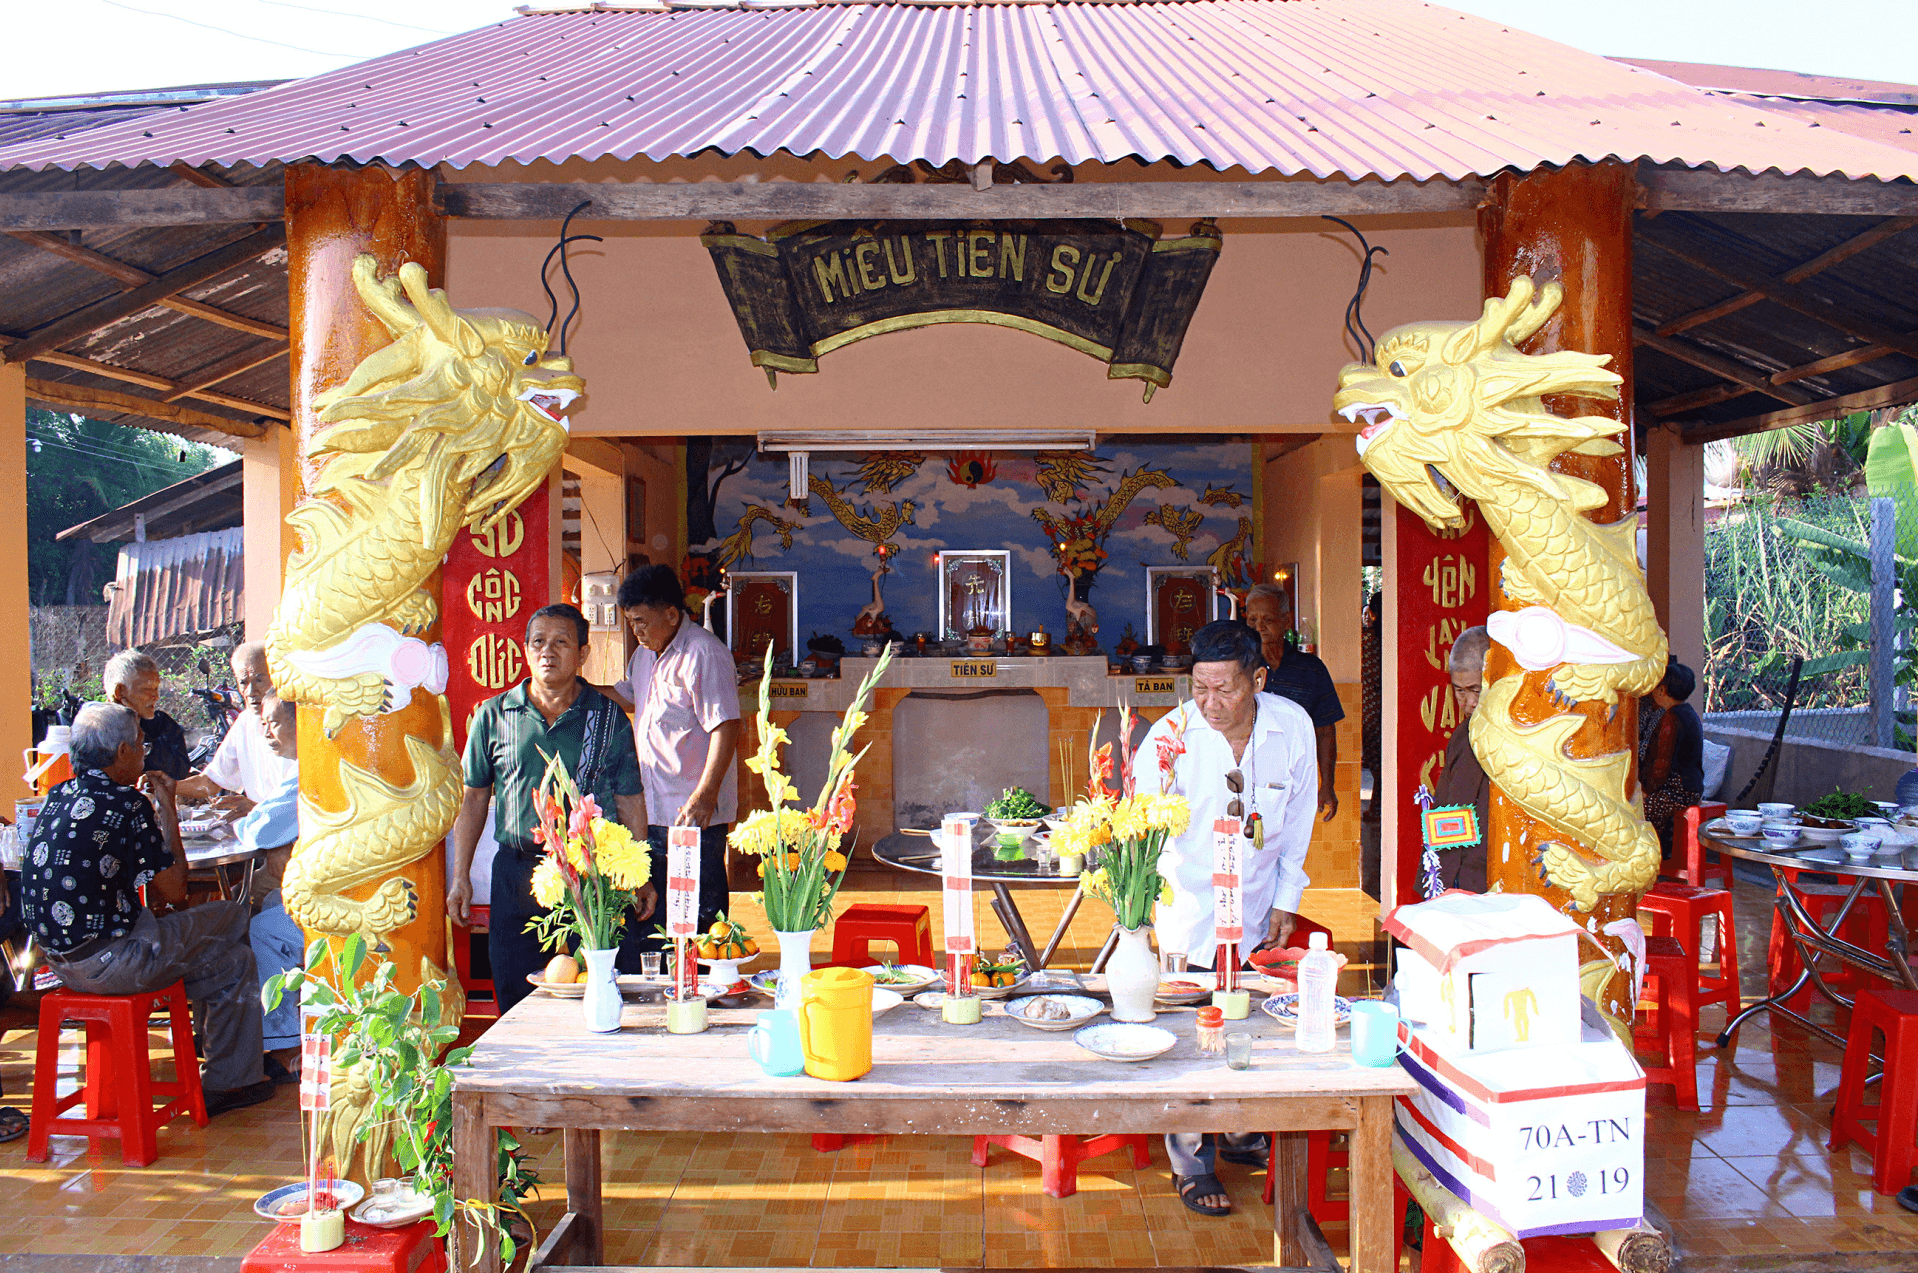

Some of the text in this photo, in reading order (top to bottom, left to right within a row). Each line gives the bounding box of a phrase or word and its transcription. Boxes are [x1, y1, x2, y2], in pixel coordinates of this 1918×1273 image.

[1046, 244, 1122, 306] SƯ
[467, 567, 521, 623] CÔNG
[467, 633, 523, 689] ĐỨC
[953, 662, 995, 676] TIÊN SƯ
[789, 687, 806, 696] BAN
[1153, 682, 1173, 691] BAN
[1519, 1117, 1630, 1150] 70A-TN
[1526, 1167, 1629, 1202] 21 19
